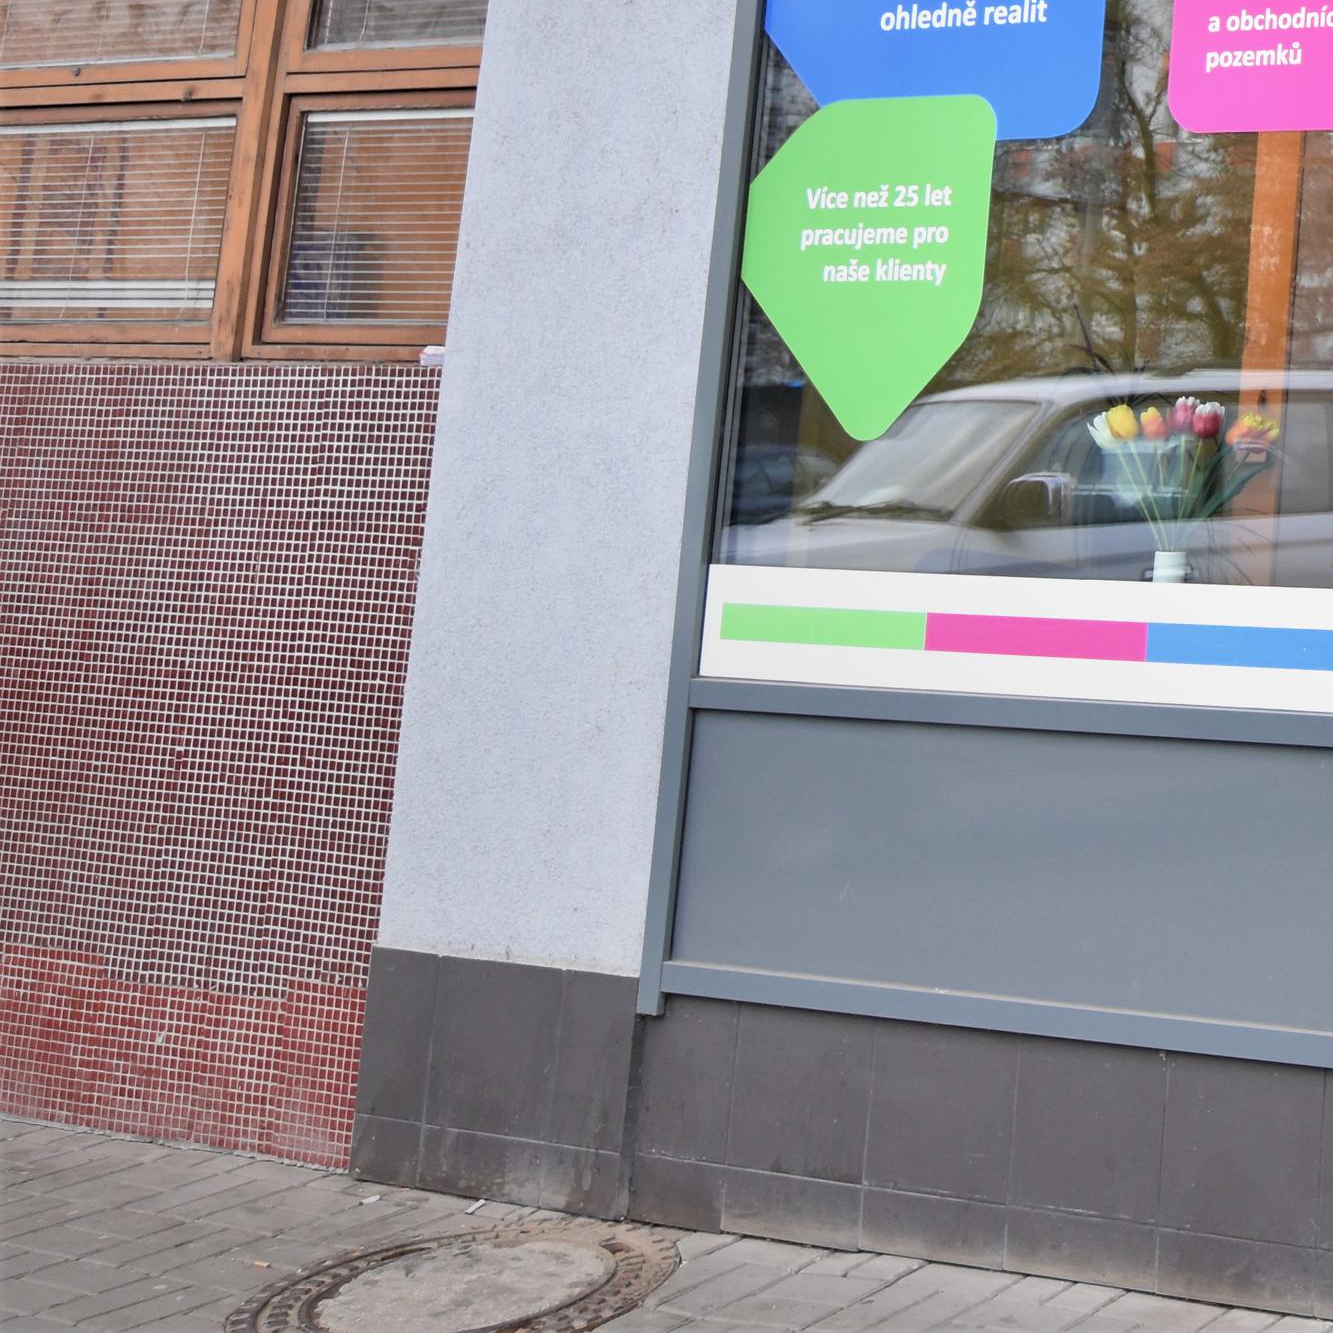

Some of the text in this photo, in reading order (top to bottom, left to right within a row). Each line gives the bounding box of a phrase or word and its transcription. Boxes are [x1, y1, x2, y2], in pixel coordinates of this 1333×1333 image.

[880, 0, 977, 31] ohledně
[1208, 15, 1220, 33] a
[1206, 41, 1302, 73] pozemků
[806, 183, 952, 209] Více než 25 let
[800, 222, 949, 251] pracujeme pro
[823, 258, 947, 286] naše klienty
